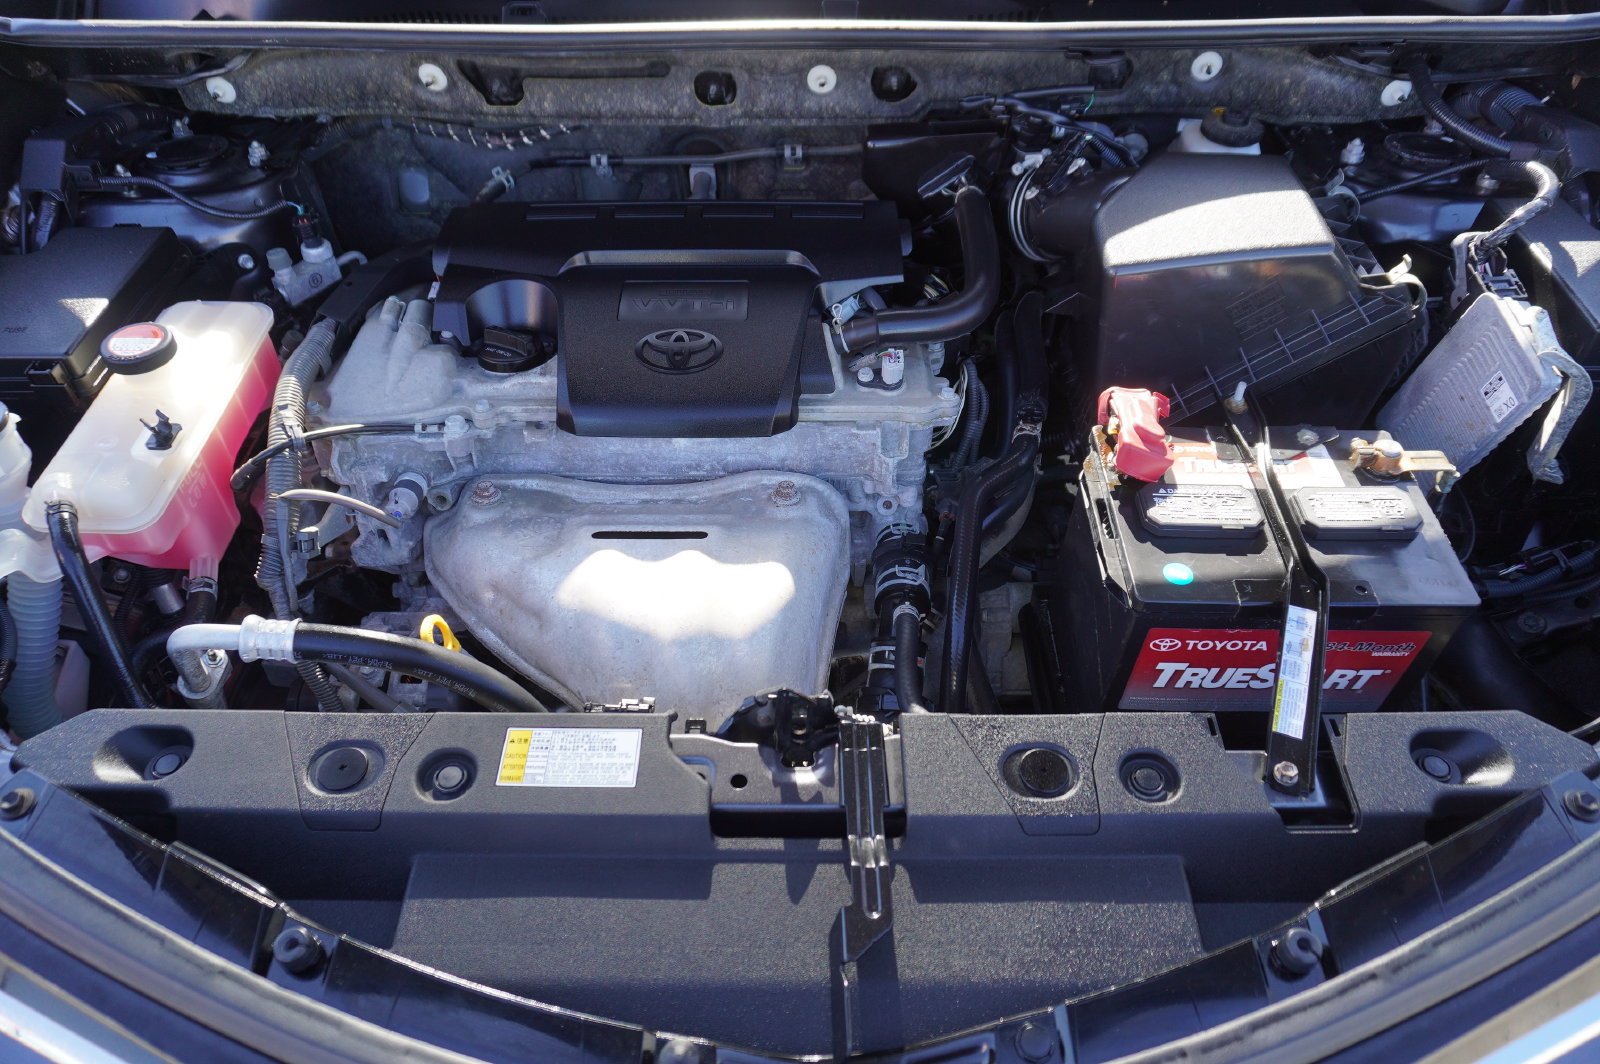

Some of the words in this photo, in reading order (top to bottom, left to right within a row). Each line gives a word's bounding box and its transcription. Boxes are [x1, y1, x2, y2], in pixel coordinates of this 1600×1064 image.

[1186, 640, 1268, 651] TOYOTA
[1325, 641, 1416, 653] 84-Month
[1152, 662, 1384, 690] TRUESRT
